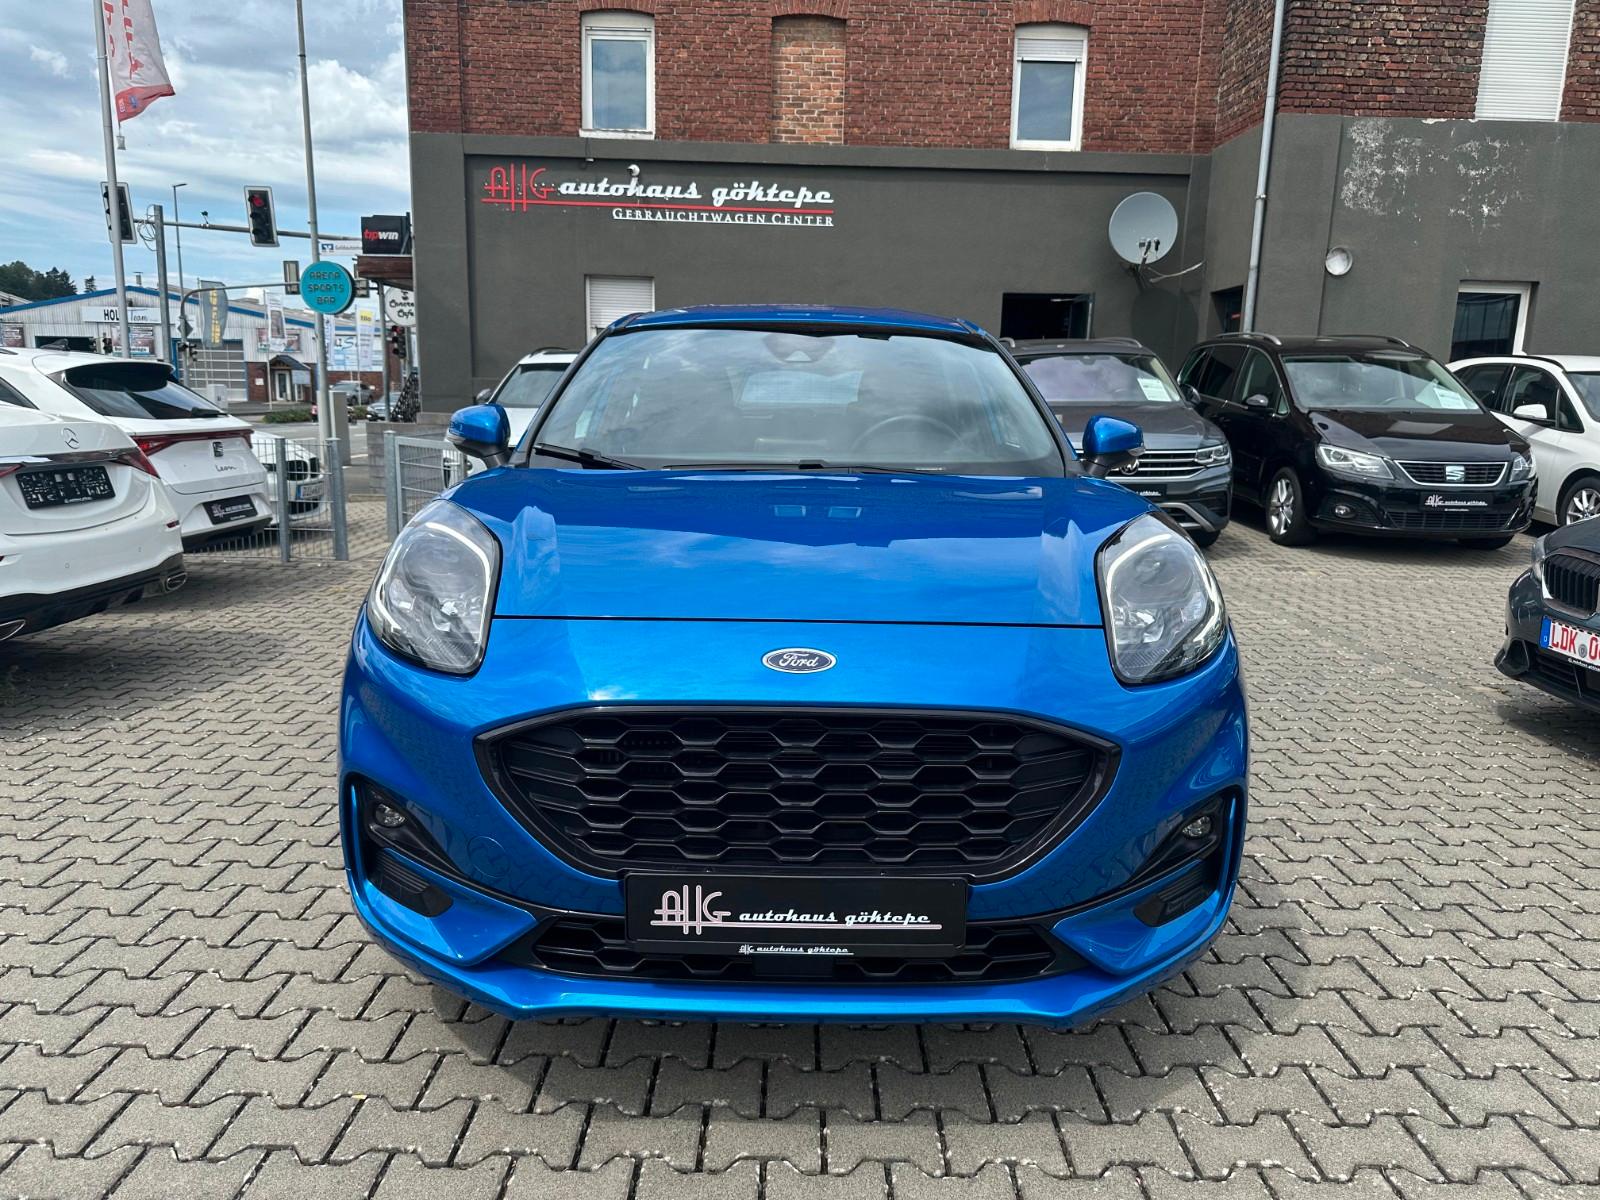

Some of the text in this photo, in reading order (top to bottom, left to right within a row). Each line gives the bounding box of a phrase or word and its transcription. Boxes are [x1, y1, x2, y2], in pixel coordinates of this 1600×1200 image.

[558, 177, 702, 199] autohaus
[711, 181, 834, 208] göktepe
[612, 208, 834, 226] GEBRAUCHTWAGEN CENTER
[309, 271, 340, 280] ARENA
[307, 283, 344, 293] SPORTS
[316, 296, 336, 305] BAR
[1551, 624, 1578, 654] LDK
[779, 652, 820, 667] Ford
[739, 908, 839, 923] autohaus
[844, 911, 931, 927] göktepe
[756, 945, 805, 953] autohaus
[806, 946, 849, 955] göktepe
